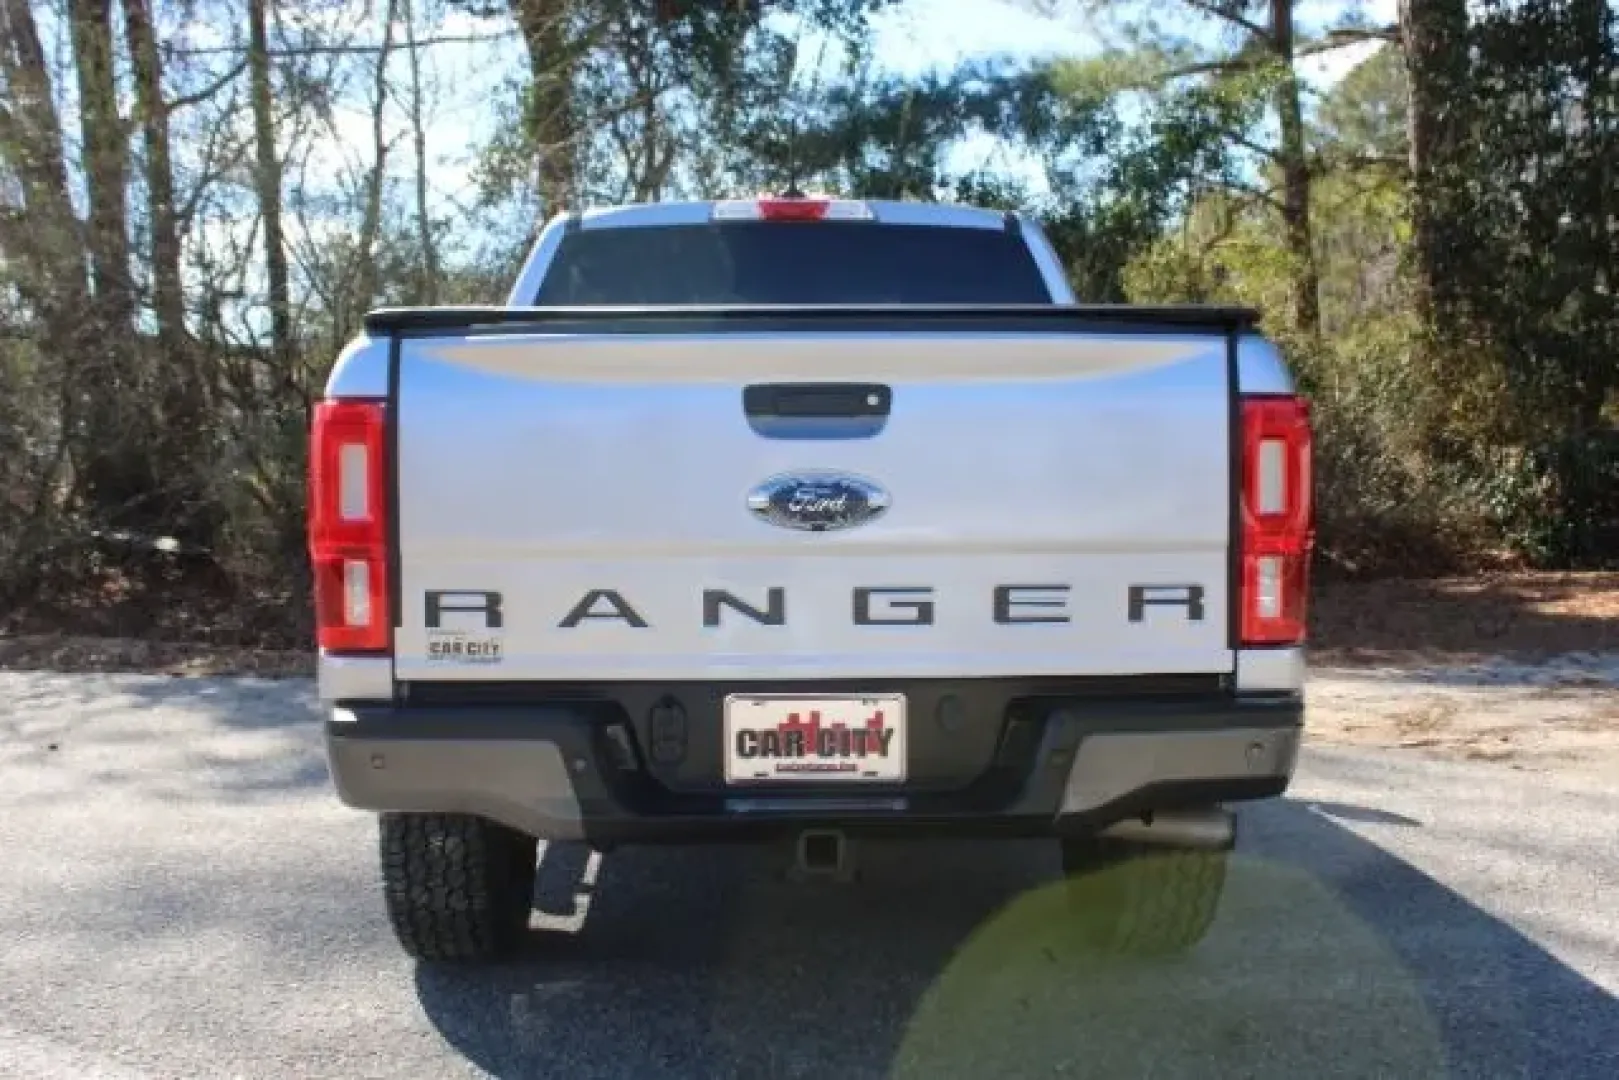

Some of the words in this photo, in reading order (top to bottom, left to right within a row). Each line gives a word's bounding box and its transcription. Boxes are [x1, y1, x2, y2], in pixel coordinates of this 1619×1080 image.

[786, 485, 848, 512] Ford
[424, 584, 1204, 628] RANGER
[736, 728, 806, 759] CAR
[817, 727, 895, 759] CITY
